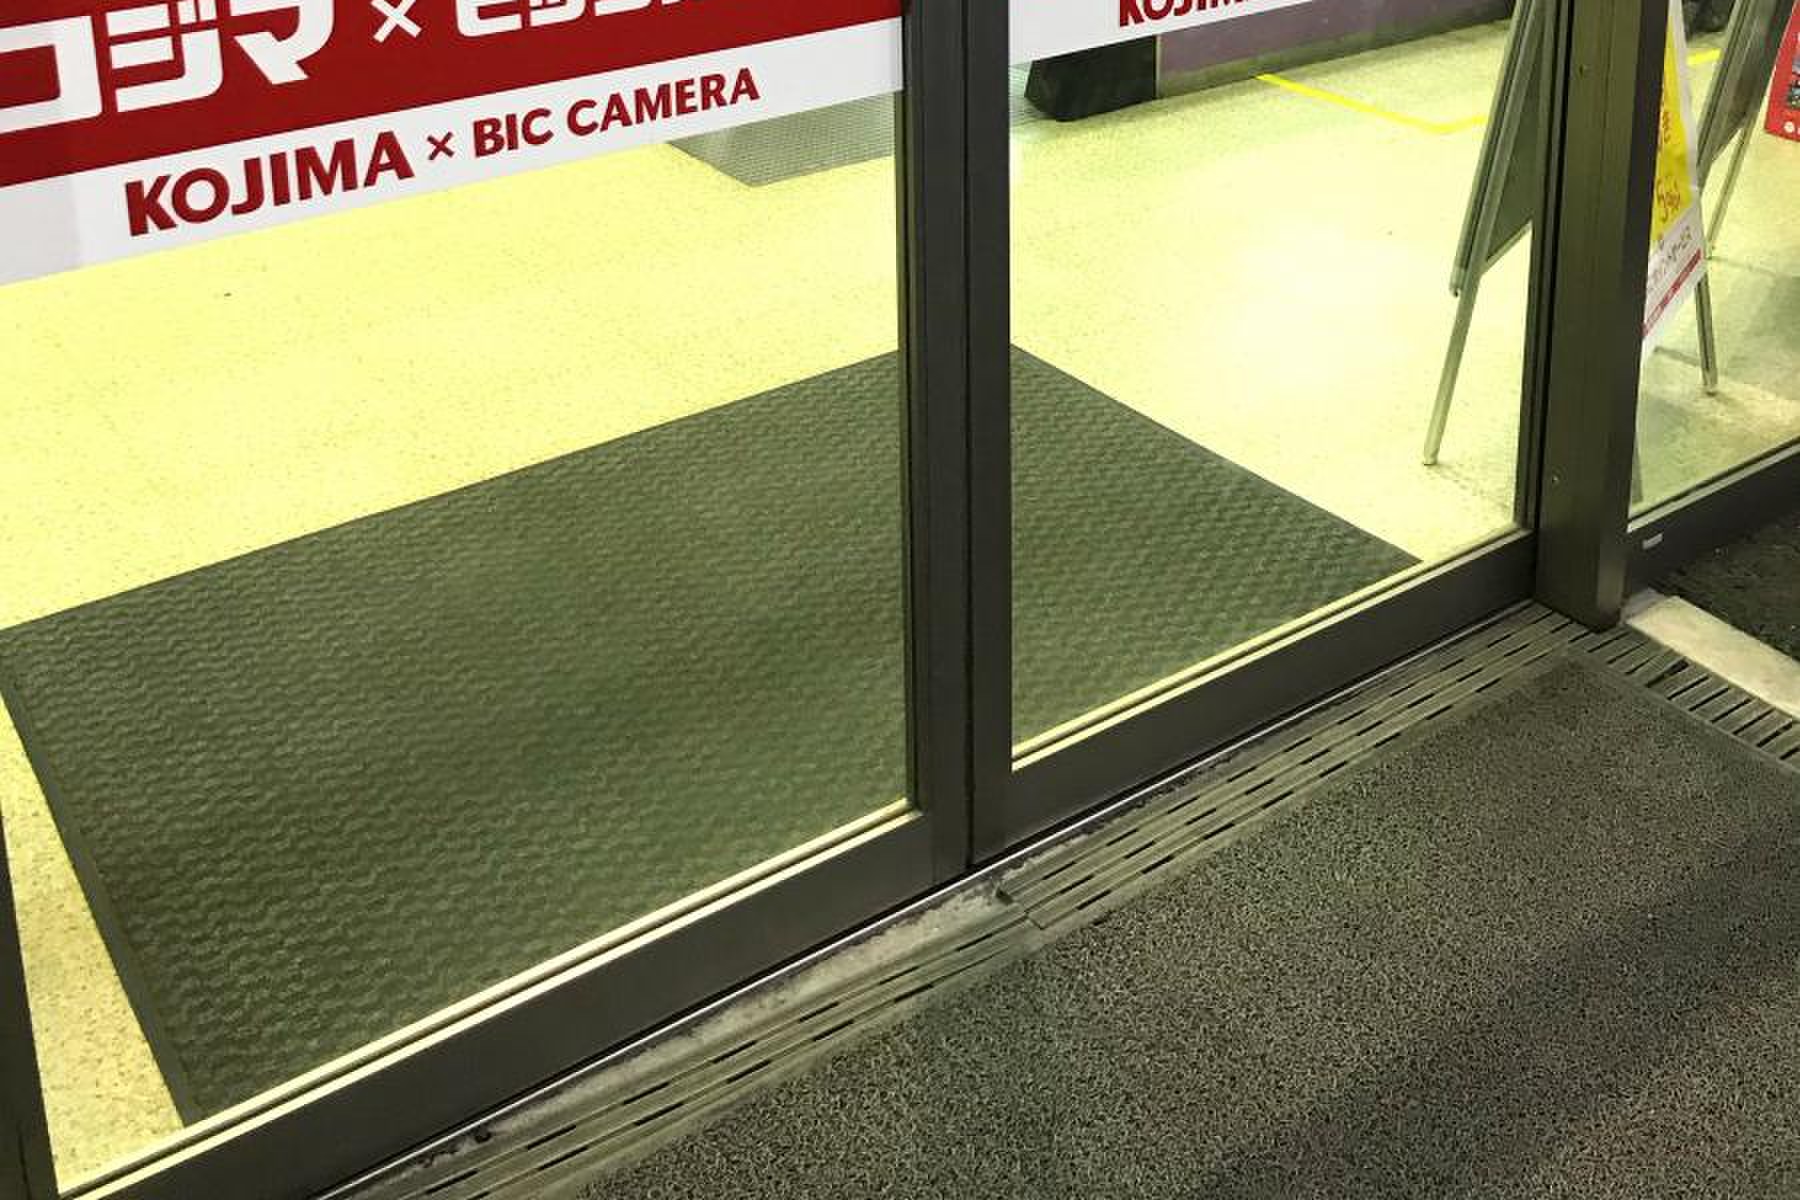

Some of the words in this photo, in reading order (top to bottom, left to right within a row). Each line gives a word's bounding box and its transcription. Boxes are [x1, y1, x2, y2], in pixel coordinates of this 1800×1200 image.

[125, 128, 415, 238] KOJIMA
[474, 107, 553, 158] BIC
[566, 66, 761, 136] CAMERA
